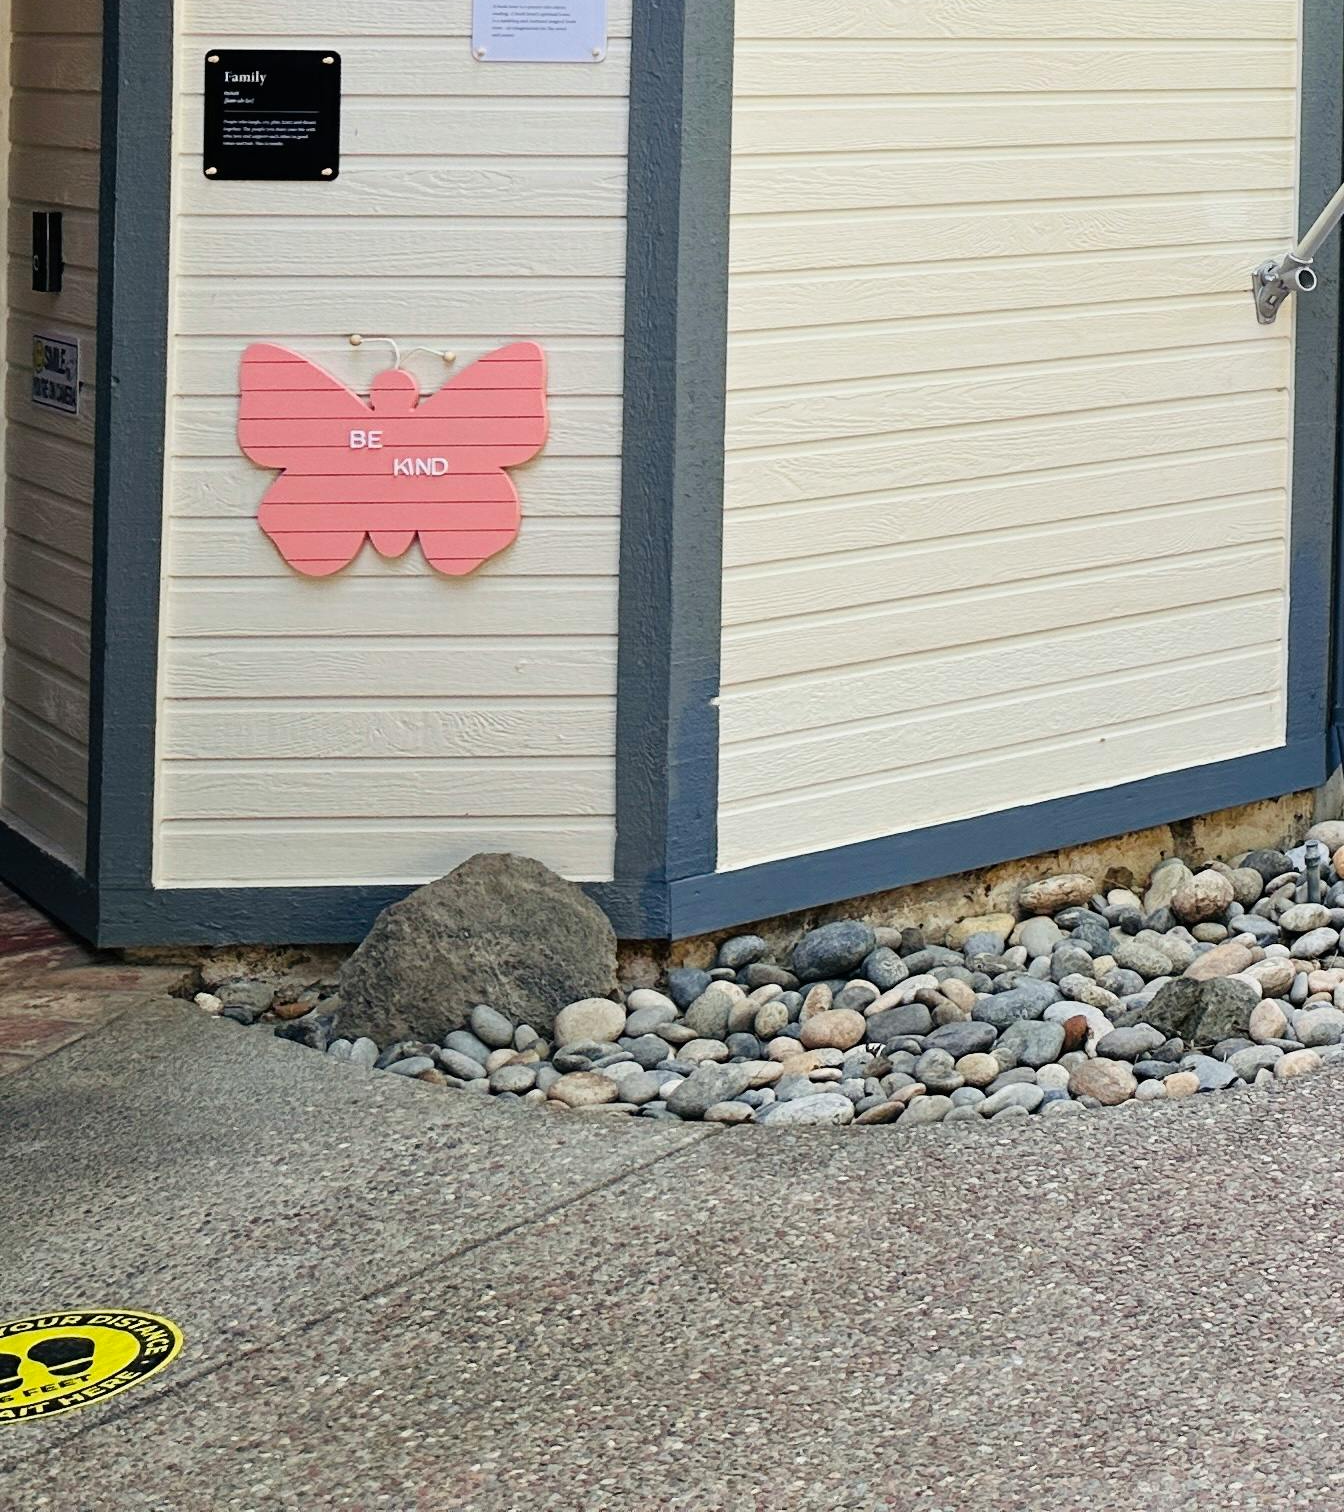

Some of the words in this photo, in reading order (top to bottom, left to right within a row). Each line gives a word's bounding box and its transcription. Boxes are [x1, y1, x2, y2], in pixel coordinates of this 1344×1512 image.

[224, 70, 267, 86] Family
[349, 429, 384, 449] BE
[393, 457, 449, 477] KIND
[86, 1315, 170, 1357] DISTANCE
[0, 1402, 50, 1419] AIT
[58, 1370, 142, 1406] HERE
[22, 1373, 91, 1398] FEET
